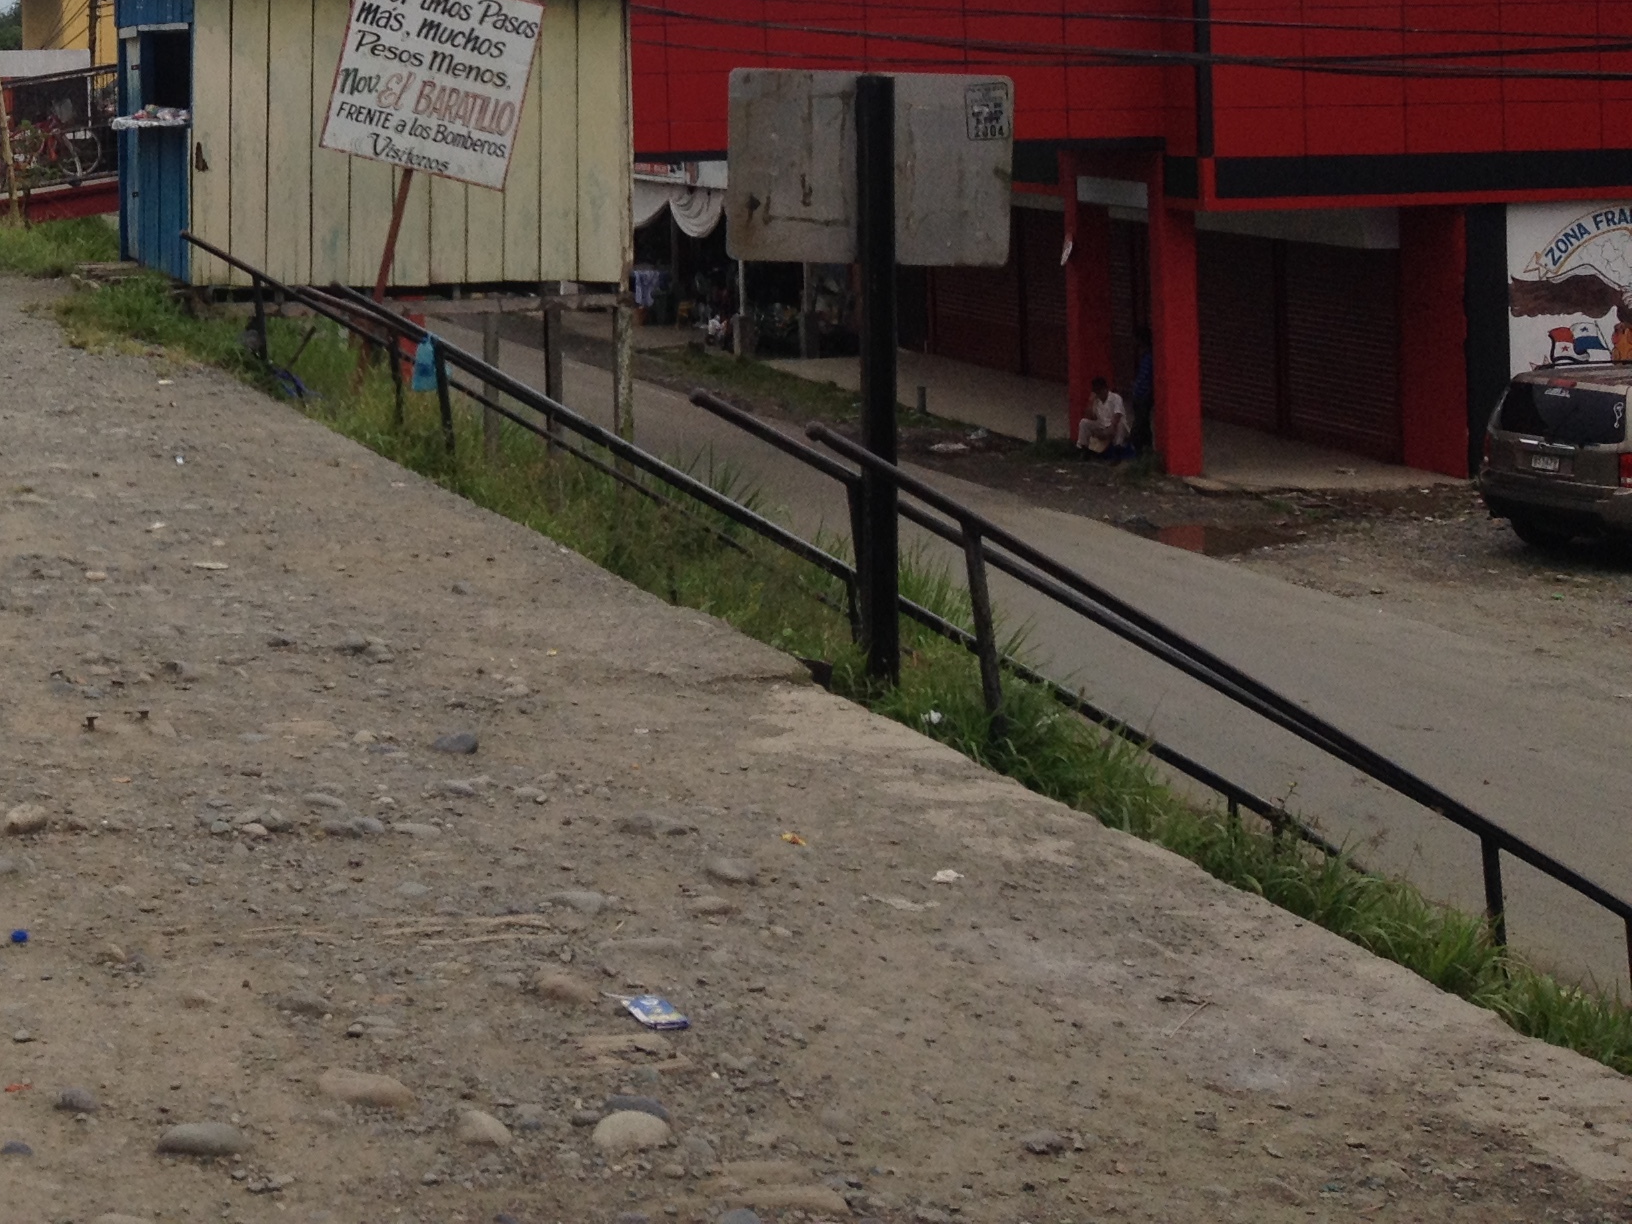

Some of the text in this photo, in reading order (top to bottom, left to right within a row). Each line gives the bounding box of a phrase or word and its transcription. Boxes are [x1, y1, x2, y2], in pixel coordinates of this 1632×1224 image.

[354, 29, 425, 68] Pesos
[336, 101, 394, 130] FRENTE
[395, 119, 407, 134] a
[408, 117, 431, 140] los
[377, 71, 417, 111] El
[412, 79, 517, 137] BARATILLO
[1544, 222, 1592, 266] ZONA
